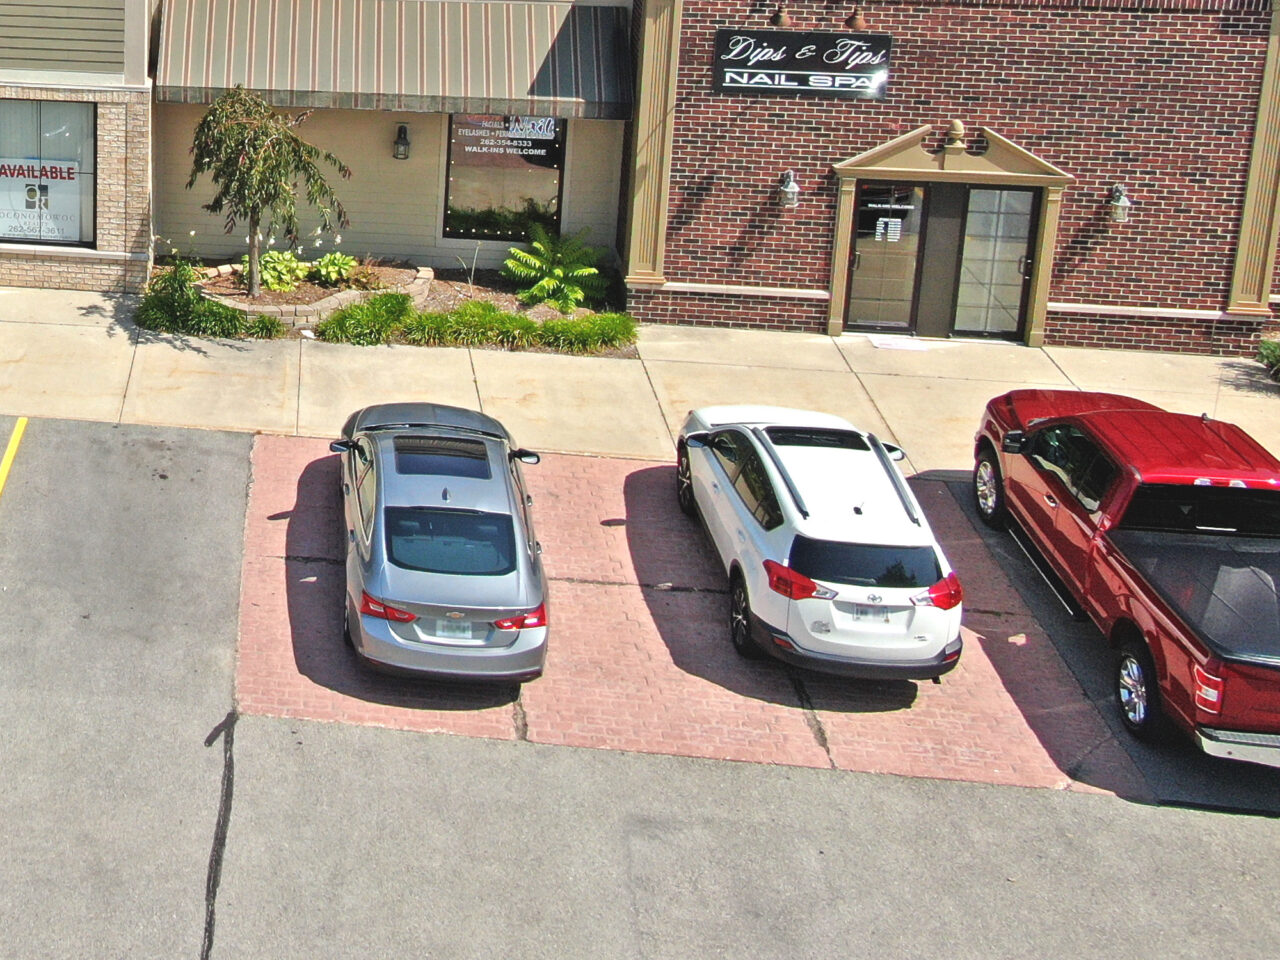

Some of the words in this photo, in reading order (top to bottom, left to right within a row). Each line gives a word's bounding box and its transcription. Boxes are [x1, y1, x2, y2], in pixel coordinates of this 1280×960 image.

[721, 35, 787, 66] Dips
[795, 45, 816, 59] &
[823, 38, 887, 70] Tips
[725, 72, 798, 86] NAIL
[808, 75, 875, 88] SPA
[458, 128, 490, 137] EYELASHES
[464, 145, 504, 154] WALK-INS
[506, 147, 547, 156] WELCOME
